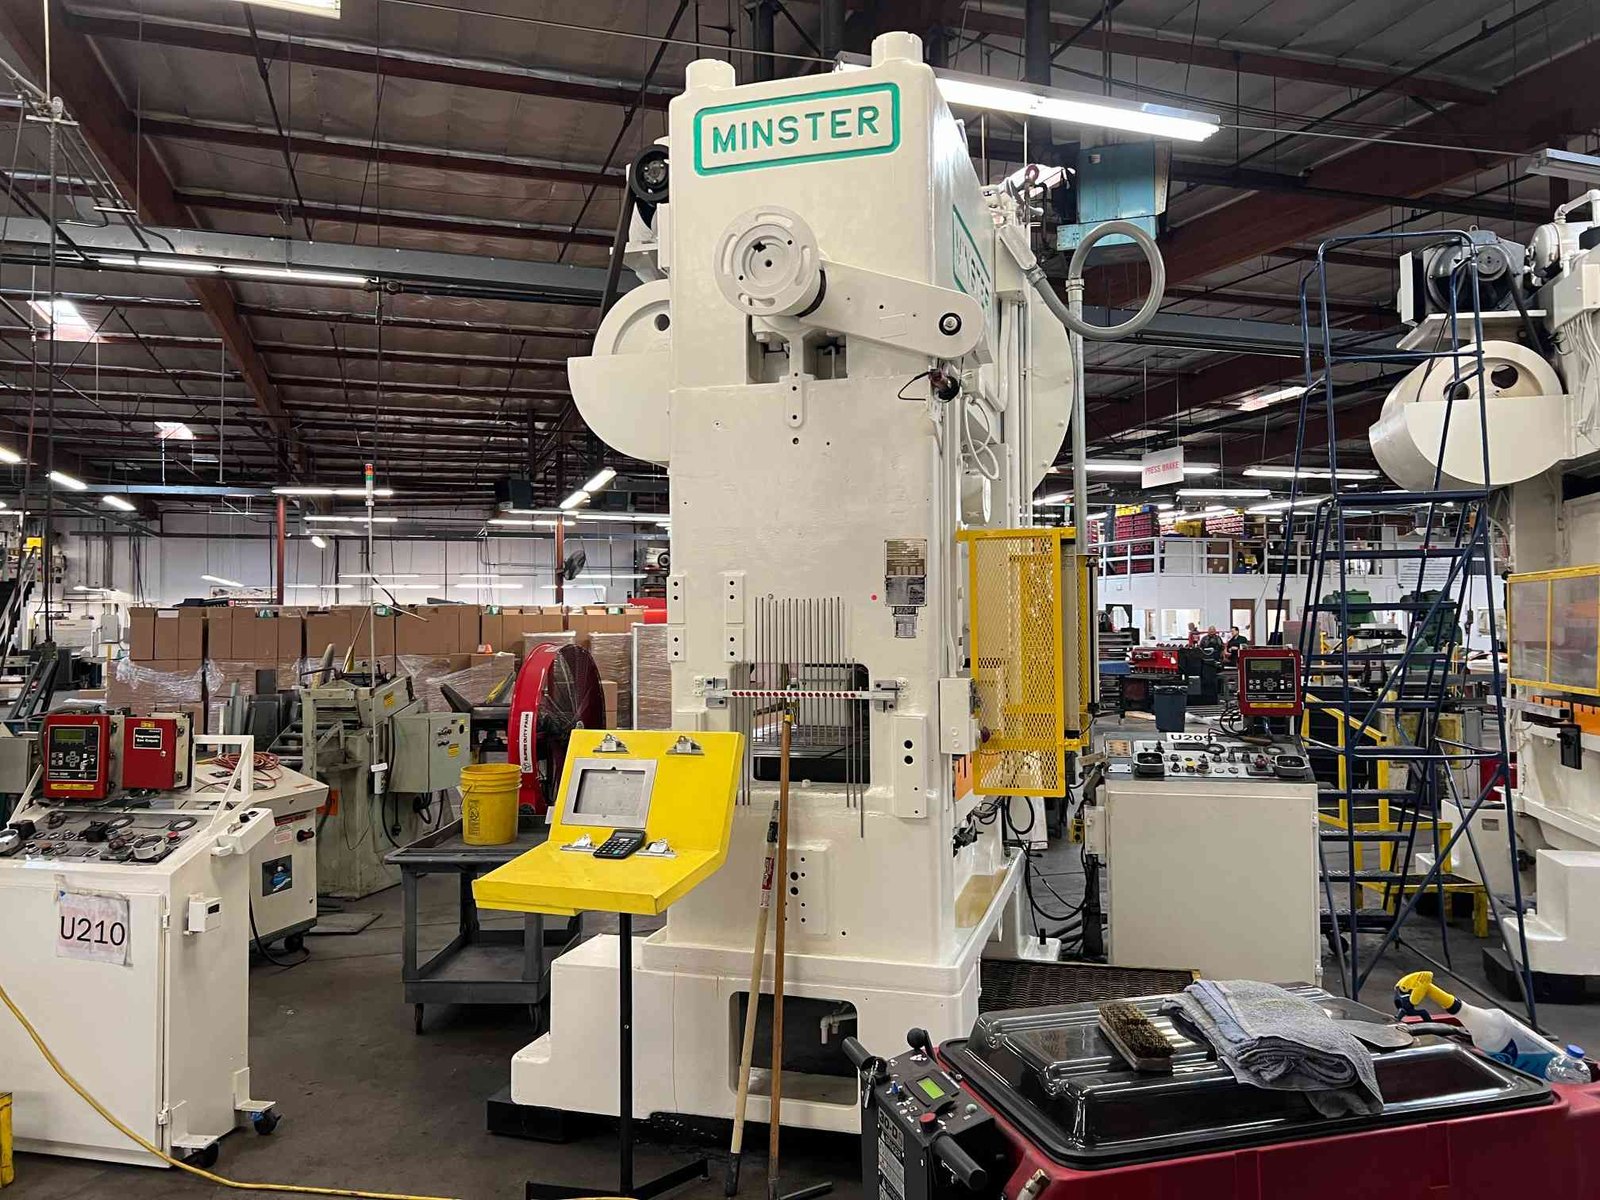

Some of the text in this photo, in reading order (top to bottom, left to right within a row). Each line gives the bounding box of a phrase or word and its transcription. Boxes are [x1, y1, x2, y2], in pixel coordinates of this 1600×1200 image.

[712, 106, 880, 154] MINSTER
[1145, 461, 1179, 475] PRESS BRAKE
[60, 915, 126, 946] U210
